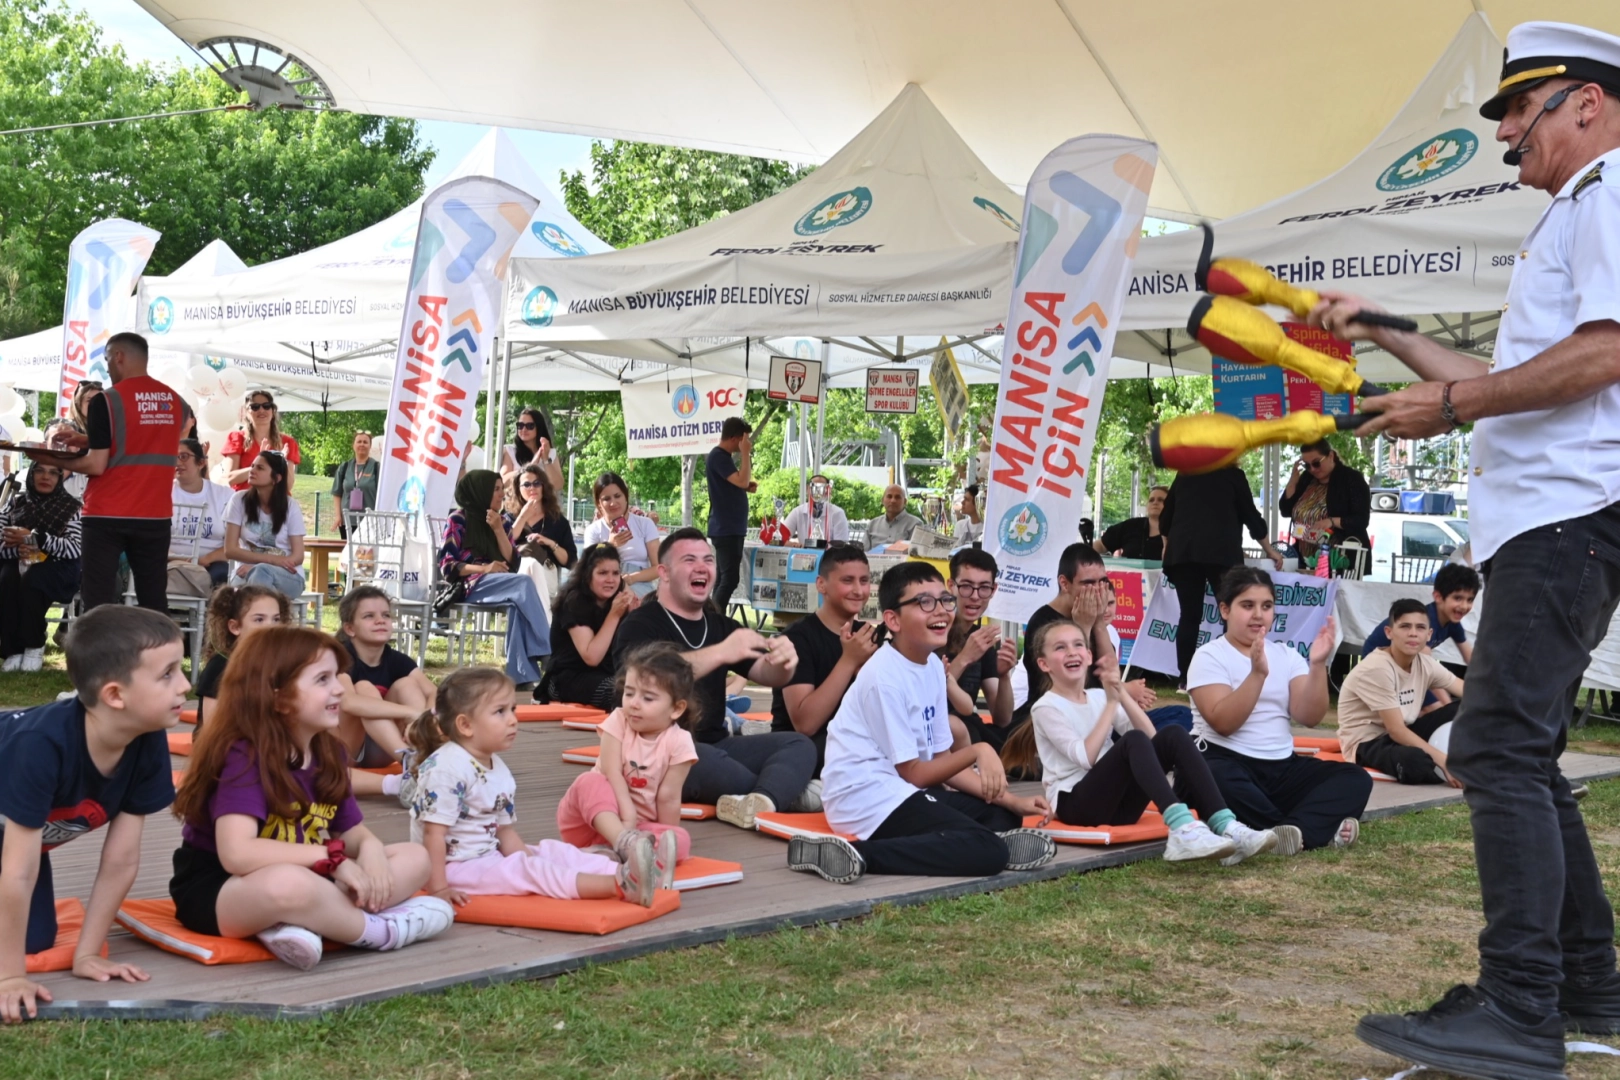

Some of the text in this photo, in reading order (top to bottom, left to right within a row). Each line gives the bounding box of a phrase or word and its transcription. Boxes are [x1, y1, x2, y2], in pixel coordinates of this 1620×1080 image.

[1379, 180, 1521, 212] ZEYREK
[1128, 270, 1188, 296] ANİSA
[1332, 246, 1461, 279] BELEDİYESİ
[1491, 255, 1515, 267] SOS
[184, 303, 224, 320] MANİSA
[226, 298, 292, 320] BÜYÜKŞEHİR
[295, 296, 357, 315] BELEDİYESİ
[568, 283, 992, 314] MANİSA BÜYÜKŞEHİR BELEDİYESİ SOSYAL HİZMETLER DAİRESİ BAŞKANLIĞI
[32, 354, 61, 365] BÜYÜKŞE
[391, 295, 448, 467] MANİSA
[883, 374, 903, 384] MANİSA
[135, 392, 174, 401] MANİSA
[874, 399, 910, 410] SPOR KULÜBÜ
[886, 388, 916, 397] ENGELLİLER
[992, 291, 1066, 494] MANİSA
[138, 402, 158, 413] İÇİN
[419, 378, 467, 475] İÇİN
[629, 424, 668, 440] MANİSA
[670, 421, 700, 438] OTİZM
[1036, 387, 1090, 499] İÇİN
[1005, 571, 1052, 587] ZEYREK
[1274, 581, 1328, 606] EDİYESİ
